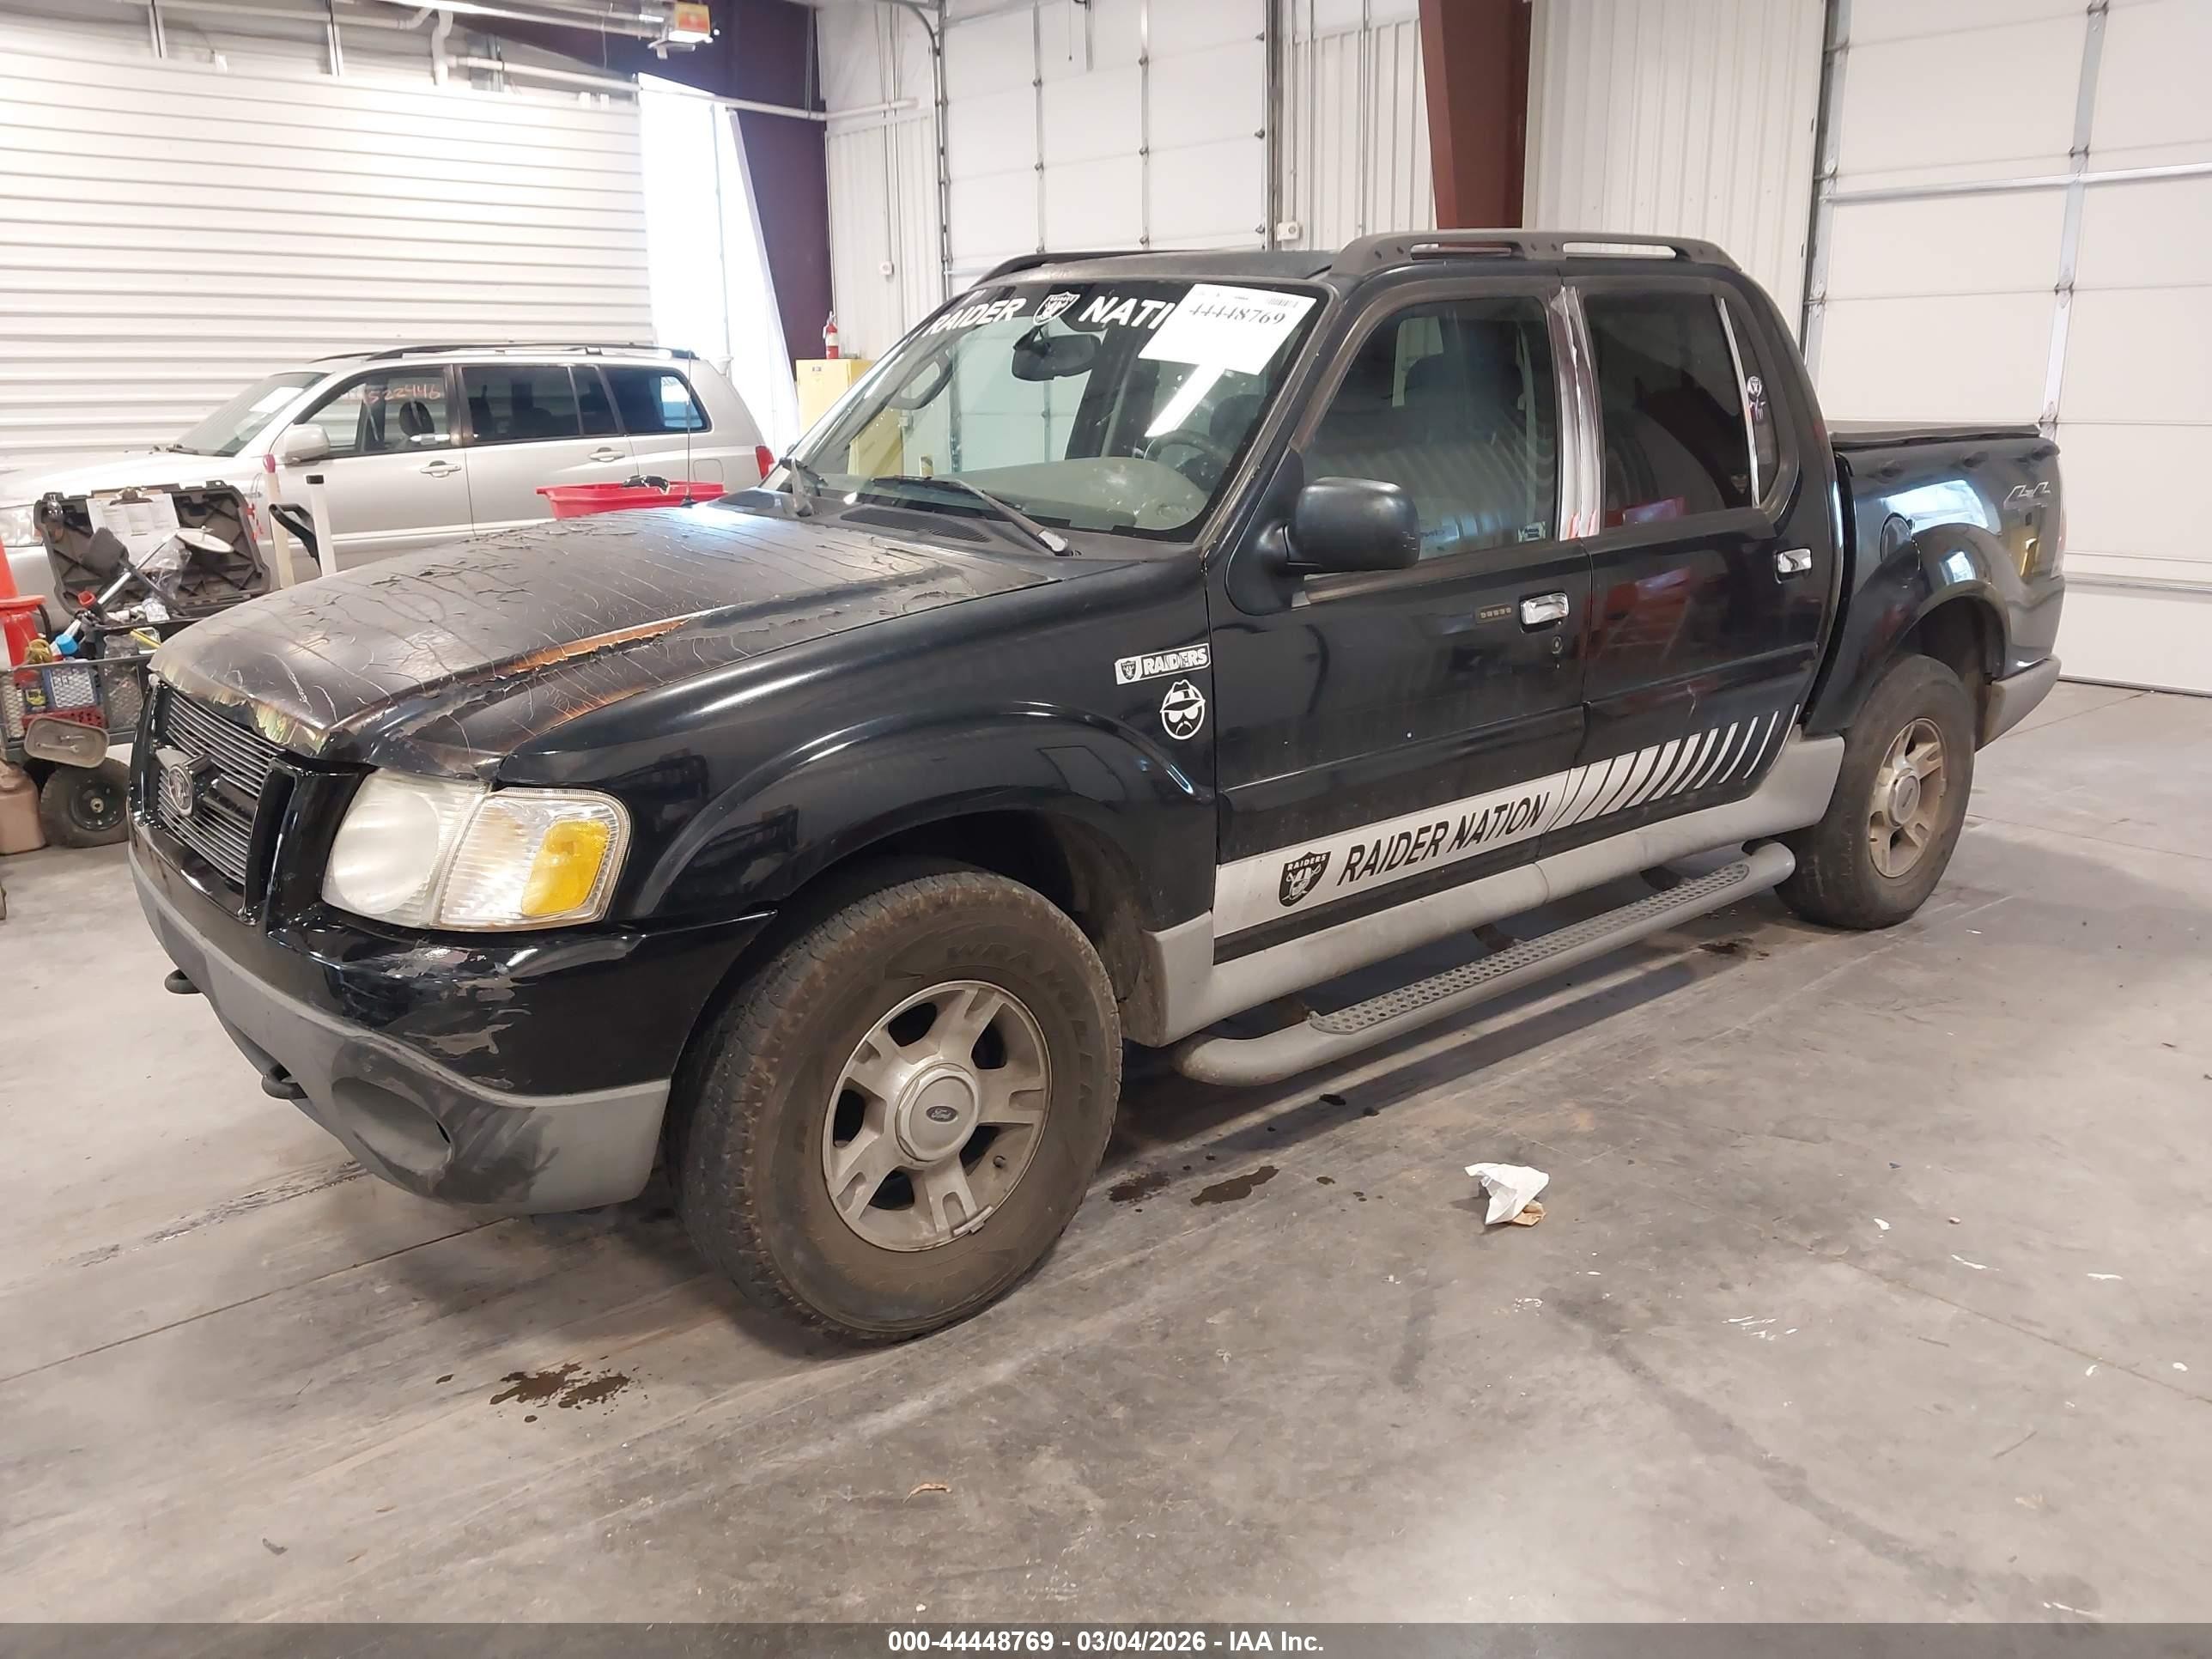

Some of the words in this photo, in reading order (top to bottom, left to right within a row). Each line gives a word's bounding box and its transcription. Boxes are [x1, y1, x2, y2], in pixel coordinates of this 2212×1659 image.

[921, 299, 1027, 337] RAIDER
[1189, 303, 1286, 325] 44448769
[1142, 647, 1208, 676] RAIDERS
[1336, 820, 1449, 886] RAIDER
[1447, 791, 1551, 854] NATION
[1287, 854, 1327, 871] RAIDERS
